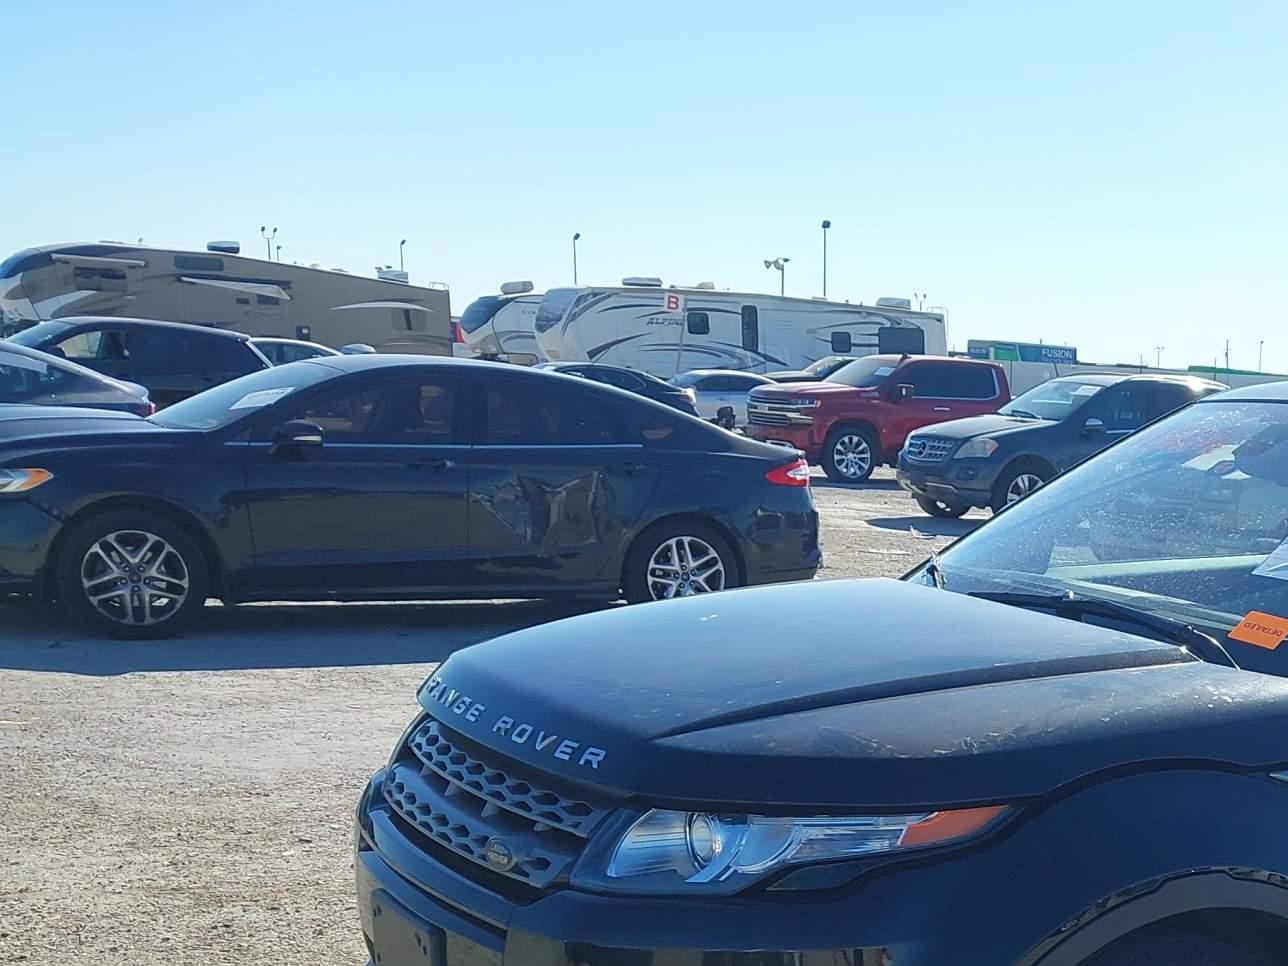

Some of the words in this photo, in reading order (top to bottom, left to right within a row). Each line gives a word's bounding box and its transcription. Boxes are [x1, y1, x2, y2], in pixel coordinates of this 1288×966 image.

[667, 294, 680, 310] B
[1041, 348, 1073, 359] FUSION
[1243, 622, 1283, 637] DETAILED
[424, 676, 486, 722] RANGE
[492, 715, 607, 769] ROVER
